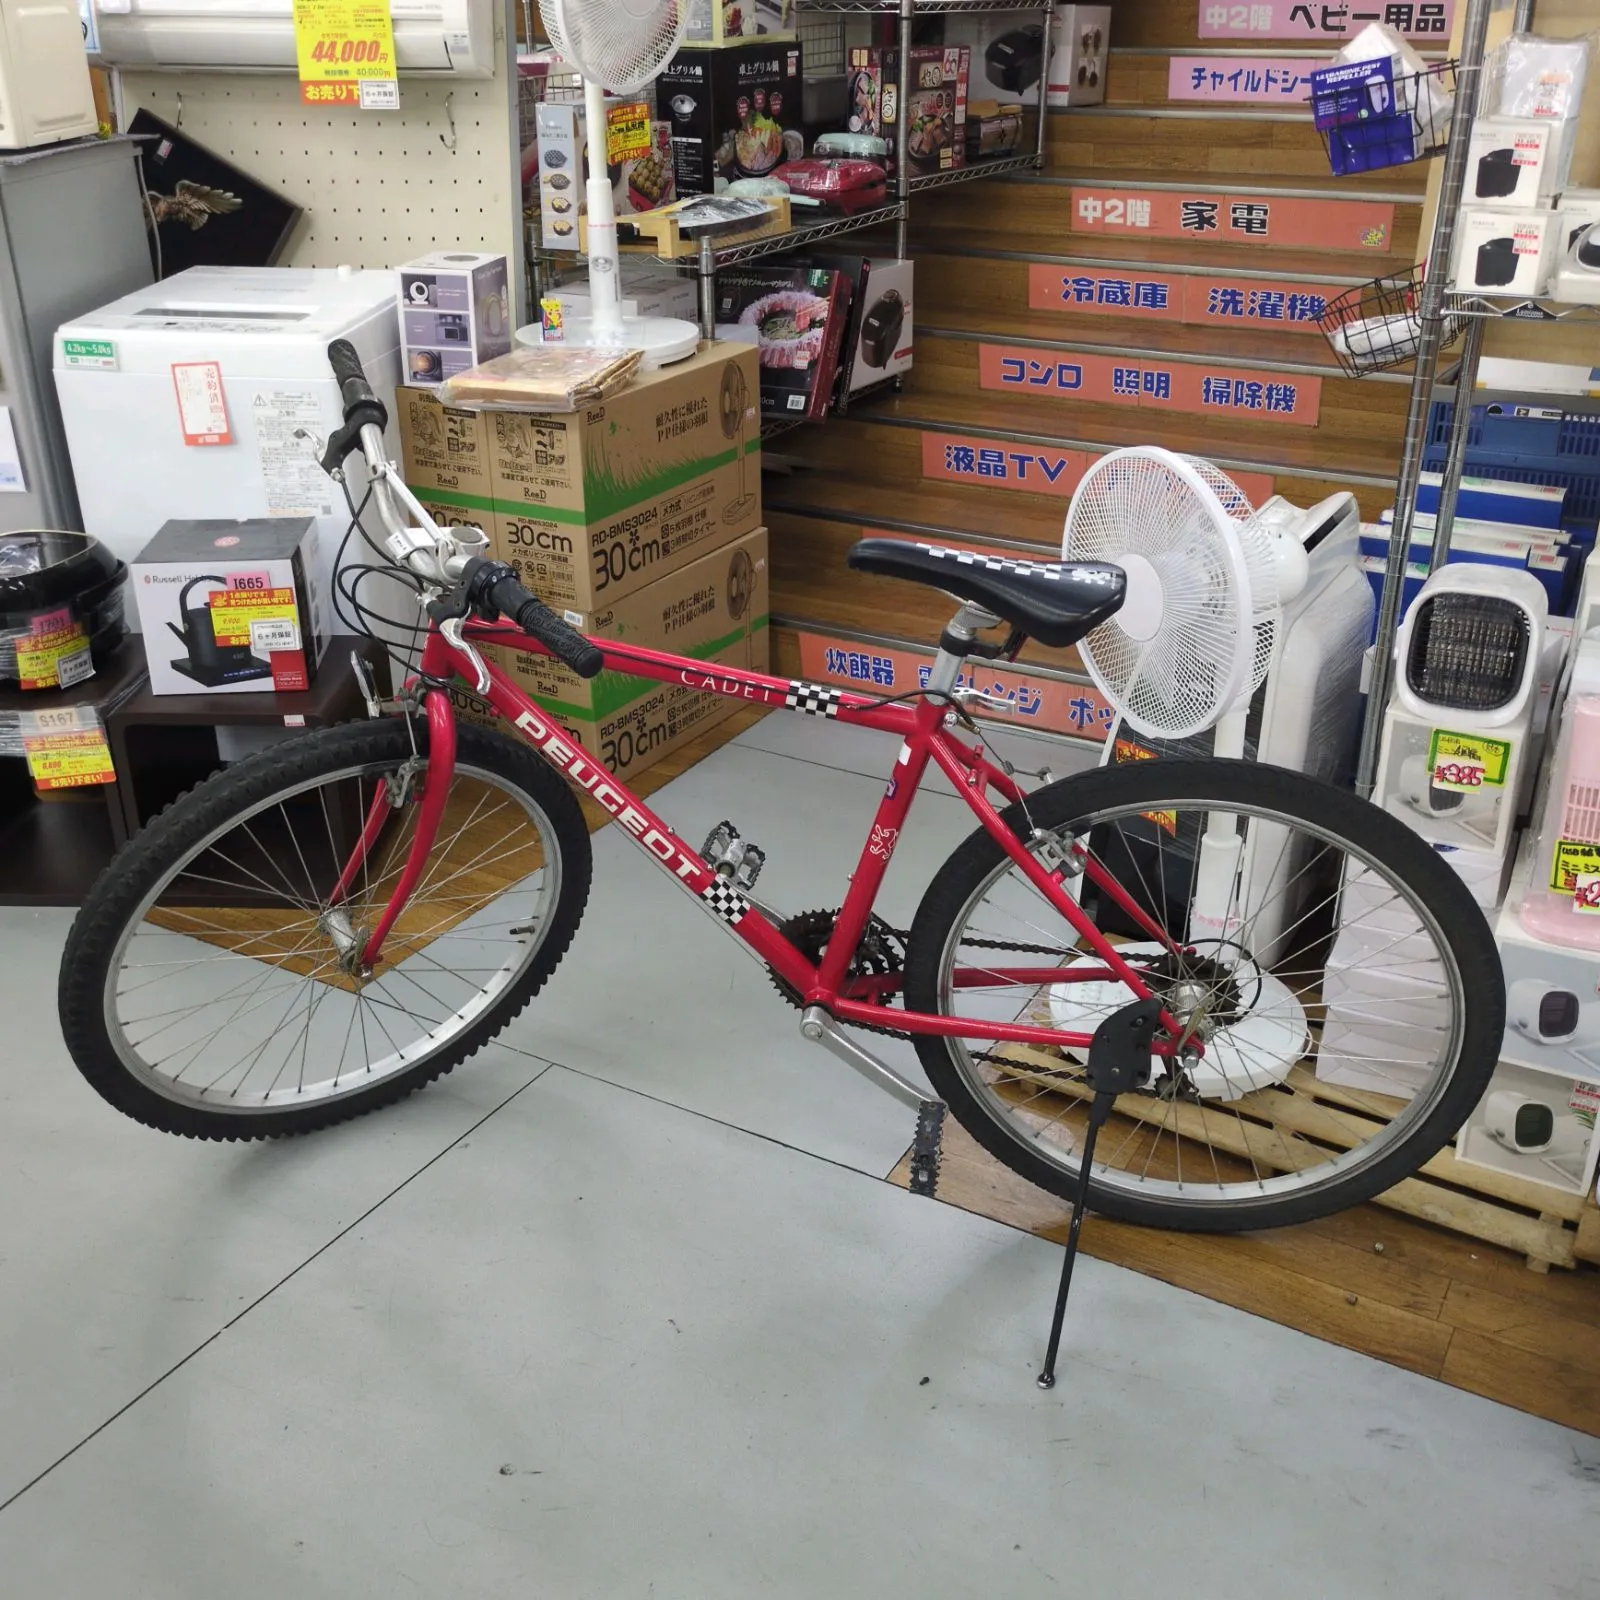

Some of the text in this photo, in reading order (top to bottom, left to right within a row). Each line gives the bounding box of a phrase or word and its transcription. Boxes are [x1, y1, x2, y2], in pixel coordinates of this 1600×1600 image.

[1205, 3, 1446, 33] 中2階 ベビー用品
[1079, 197, 1151, 227] 中2階
[1061, 275, 1327, 322] 冷蔵庫 洗濯機
[1001, 357, 1298, 415] コンロ 照明 掃除機
[943, 443, 1069, 485] 液晶TV
[506, 521, 573, 554] 30cm
[591, 506, 658, 548] RD-BMS3024
[152, 575, 182, 584] Russell
[593, 538, 661, 592] 30cm
[681, 666, 775, 702] CADET
[825, 646, 896, 688] 炊飯器
[601, 722, 668, 775] 30cm
[514, 710, 702, 881] PEUGEOT
[1434, 763, 1486, 787] ¥385
